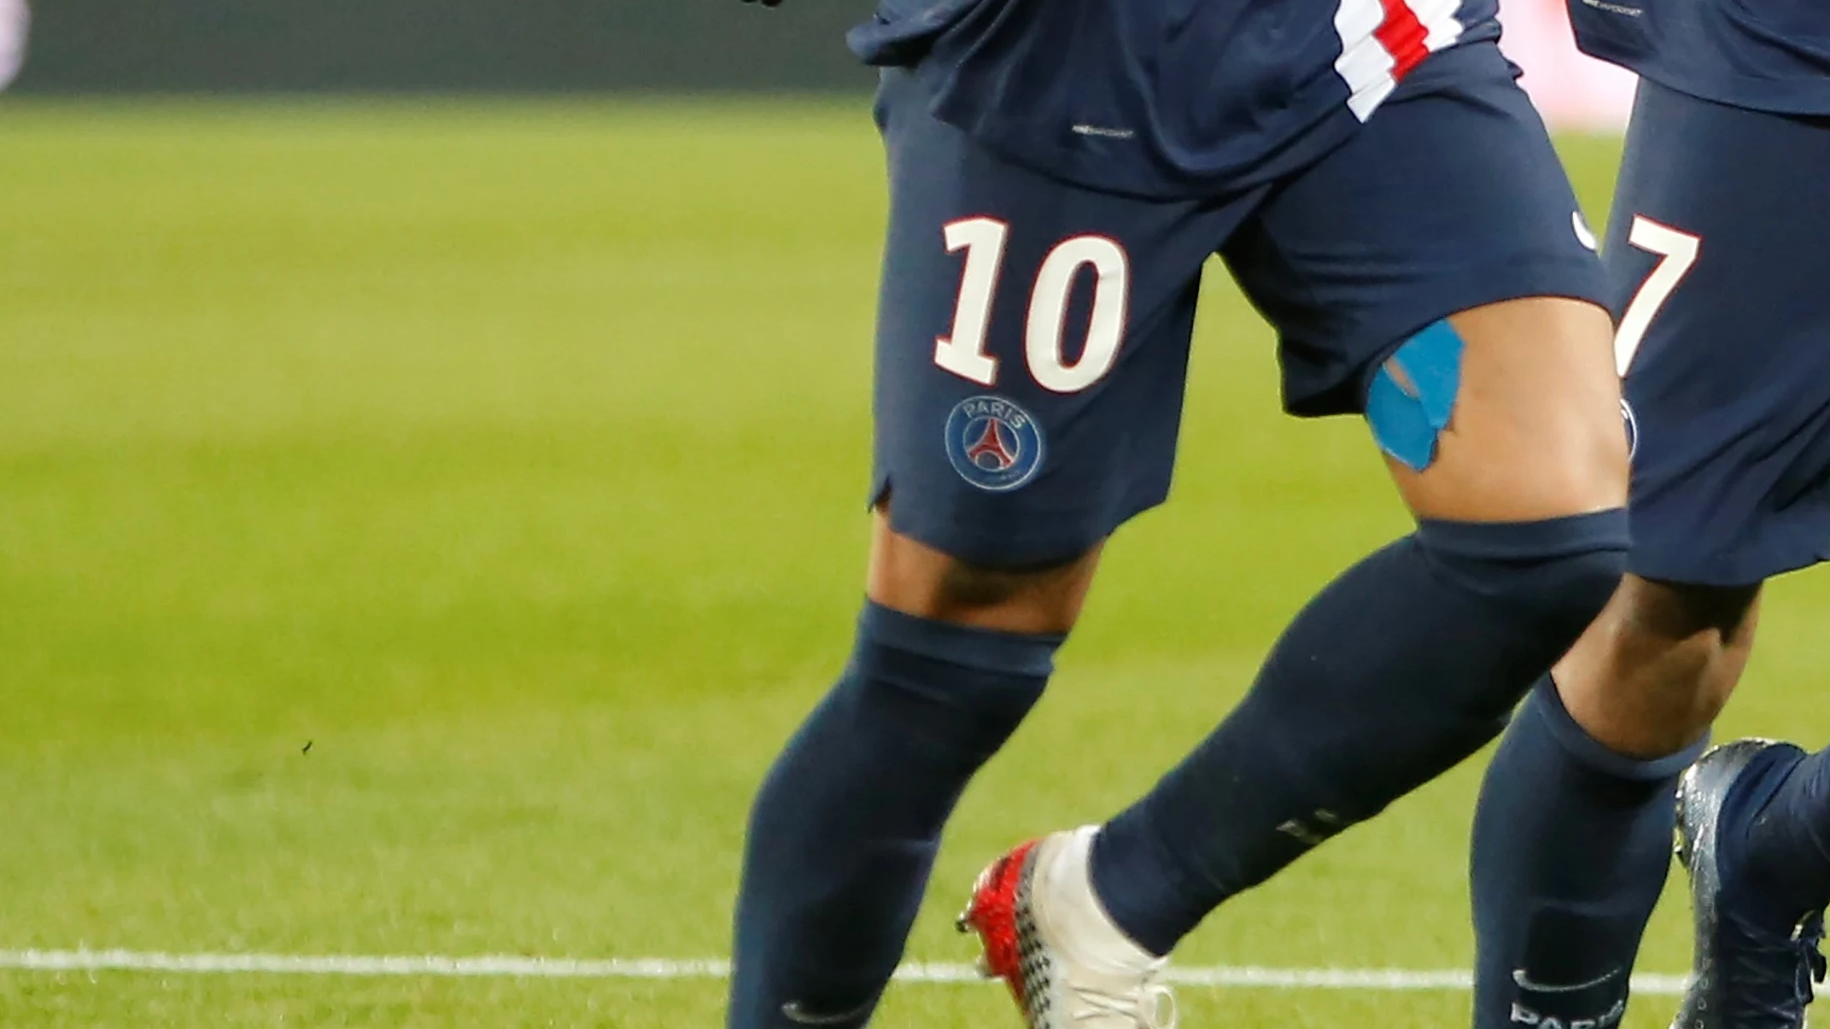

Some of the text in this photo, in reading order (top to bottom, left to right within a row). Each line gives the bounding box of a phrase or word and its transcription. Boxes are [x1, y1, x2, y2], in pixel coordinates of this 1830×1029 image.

[931, 213, 1132, 395] 10
[1613, 213, 1704, 380] 7
[962, 400, 1026, 430] PARIS
